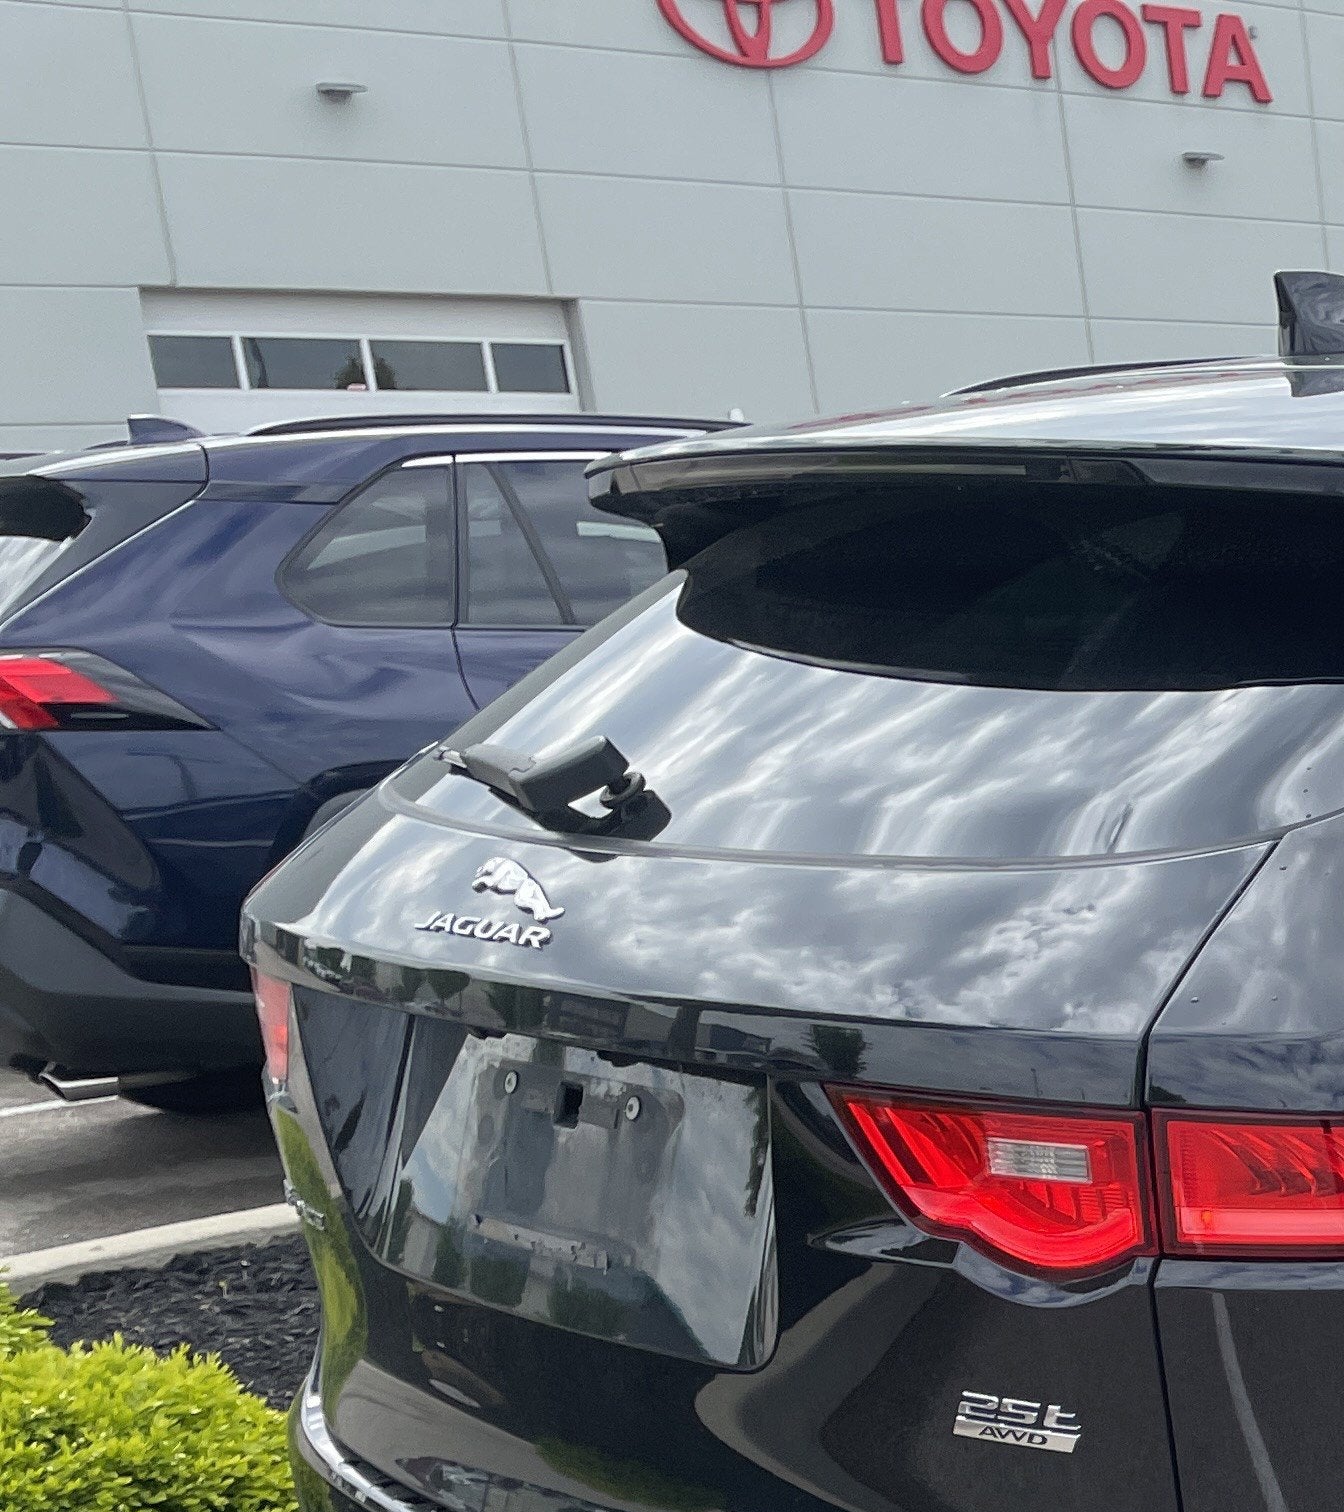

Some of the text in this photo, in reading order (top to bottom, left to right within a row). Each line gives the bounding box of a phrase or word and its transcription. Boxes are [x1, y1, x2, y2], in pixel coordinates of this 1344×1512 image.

[414, 911, 551, 949] JAGUAR
[957, 1390, 1082, 1430] 25t
[978, 1426, 1048, 1446] AWD
